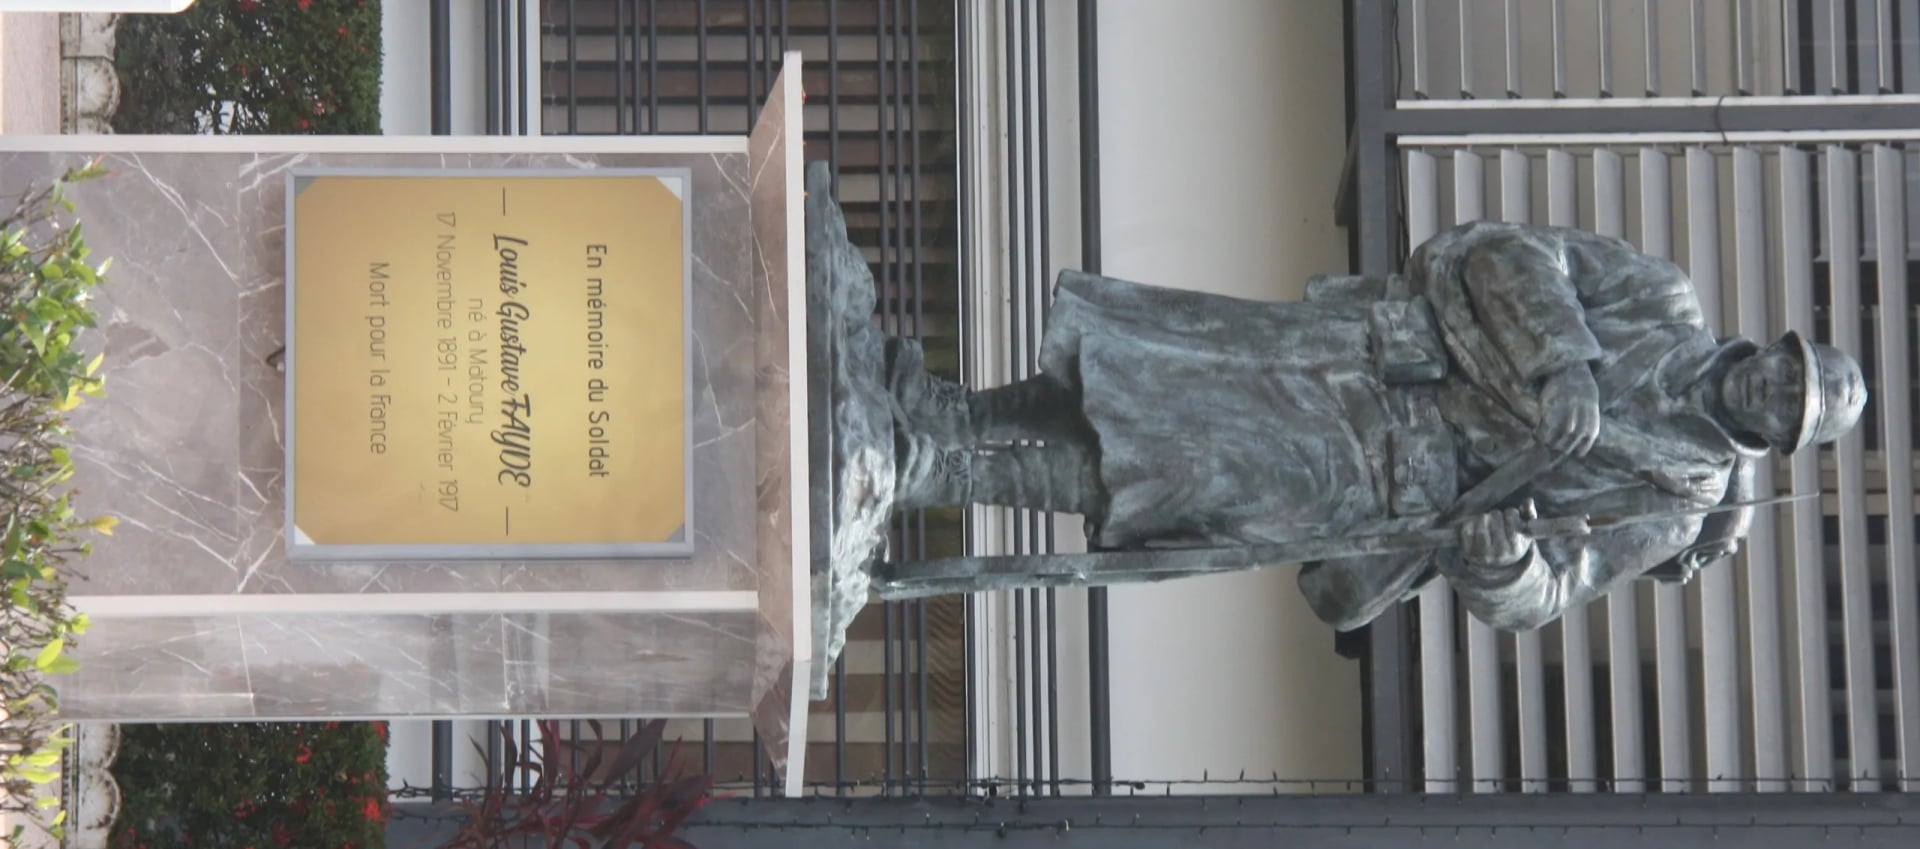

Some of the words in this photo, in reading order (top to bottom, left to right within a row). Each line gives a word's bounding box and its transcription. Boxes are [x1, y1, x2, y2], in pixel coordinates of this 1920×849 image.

[436, 211, 456, 227] 17
[493, 233, 528, 296] Louis
[585, 244, 607, 269] En
[369, 262, 390, 307] Mort
[436, 234, 456, 330] Novembre
[468, 298, 486, 322] né
[586, 277, 609, 370] mémoire
[364, 315, 386, 361] pour
[437, 336, 457, 371] 1891
[468, 330, 487, 342] à
[496, 301, 530, 392] Gustave
[369, 369, 391, 386] la
[437, 393, 458, 404] 2
[465, 348, 488, 424] Matoury
[587, 378, 609, 403] du
[369, 394, 391, 454] France
[437, 410, 458, 471] Février
[490, 393, 531, 488] FAYDE
[588, 410, 610, 478] Soldat
[438, 479, 459, 512] 1917
